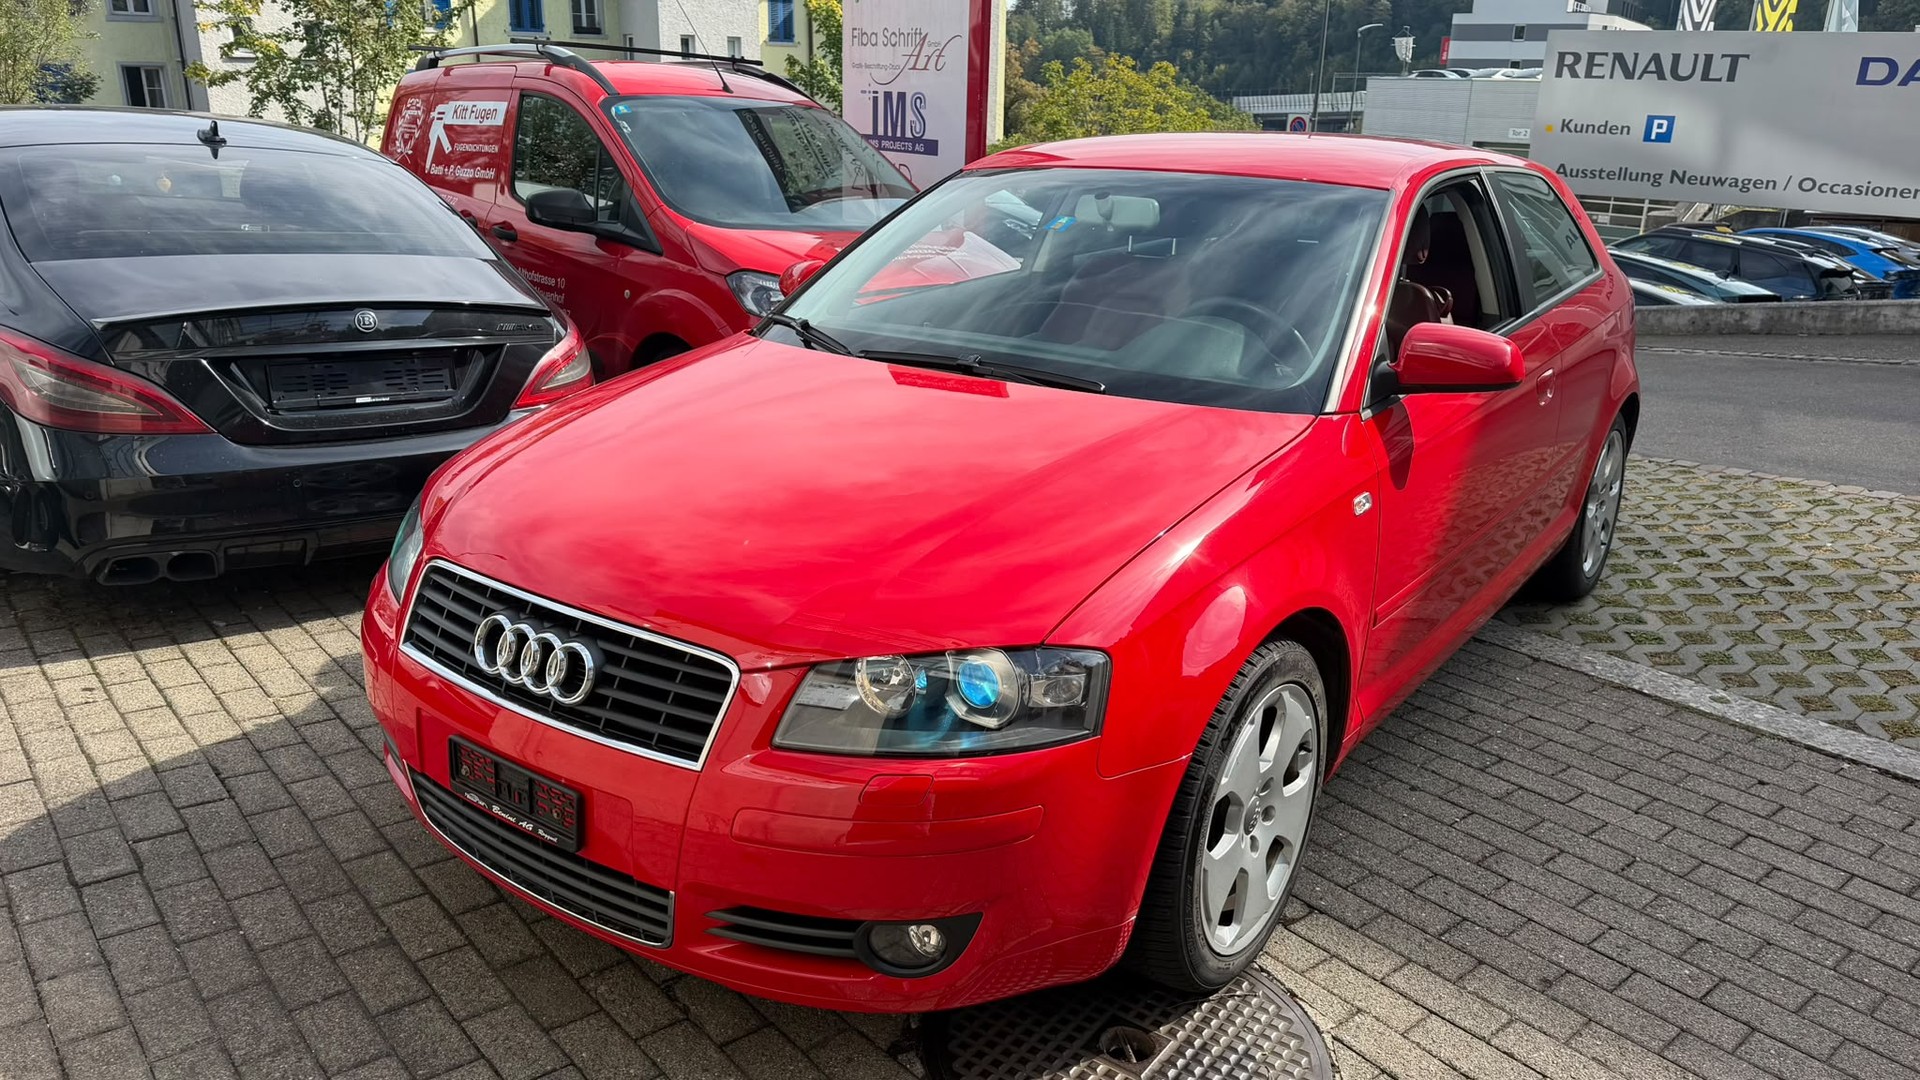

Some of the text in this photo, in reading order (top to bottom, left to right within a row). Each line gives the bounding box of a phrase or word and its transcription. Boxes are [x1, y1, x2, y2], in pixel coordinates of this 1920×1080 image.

[851, 27, 924, 48] Fiba Schrift
[1554, 51, 1751, 83] RENAULT
[452, 104, 498, 124] Kitt Fugen
[1560, 118, 1631, 136] Kunden
[881, 140, 912, 151] PROJECTS
[914, 143, 925, 152] AG
[474, 166, 496, 179] GmbH
[1556, 163, 1664, 187] Ausstellung
[1669, 169, 1777, 193] Neuwagen
[557, 277, 566, 289] 10
[518, 820, 534, 832] AG
